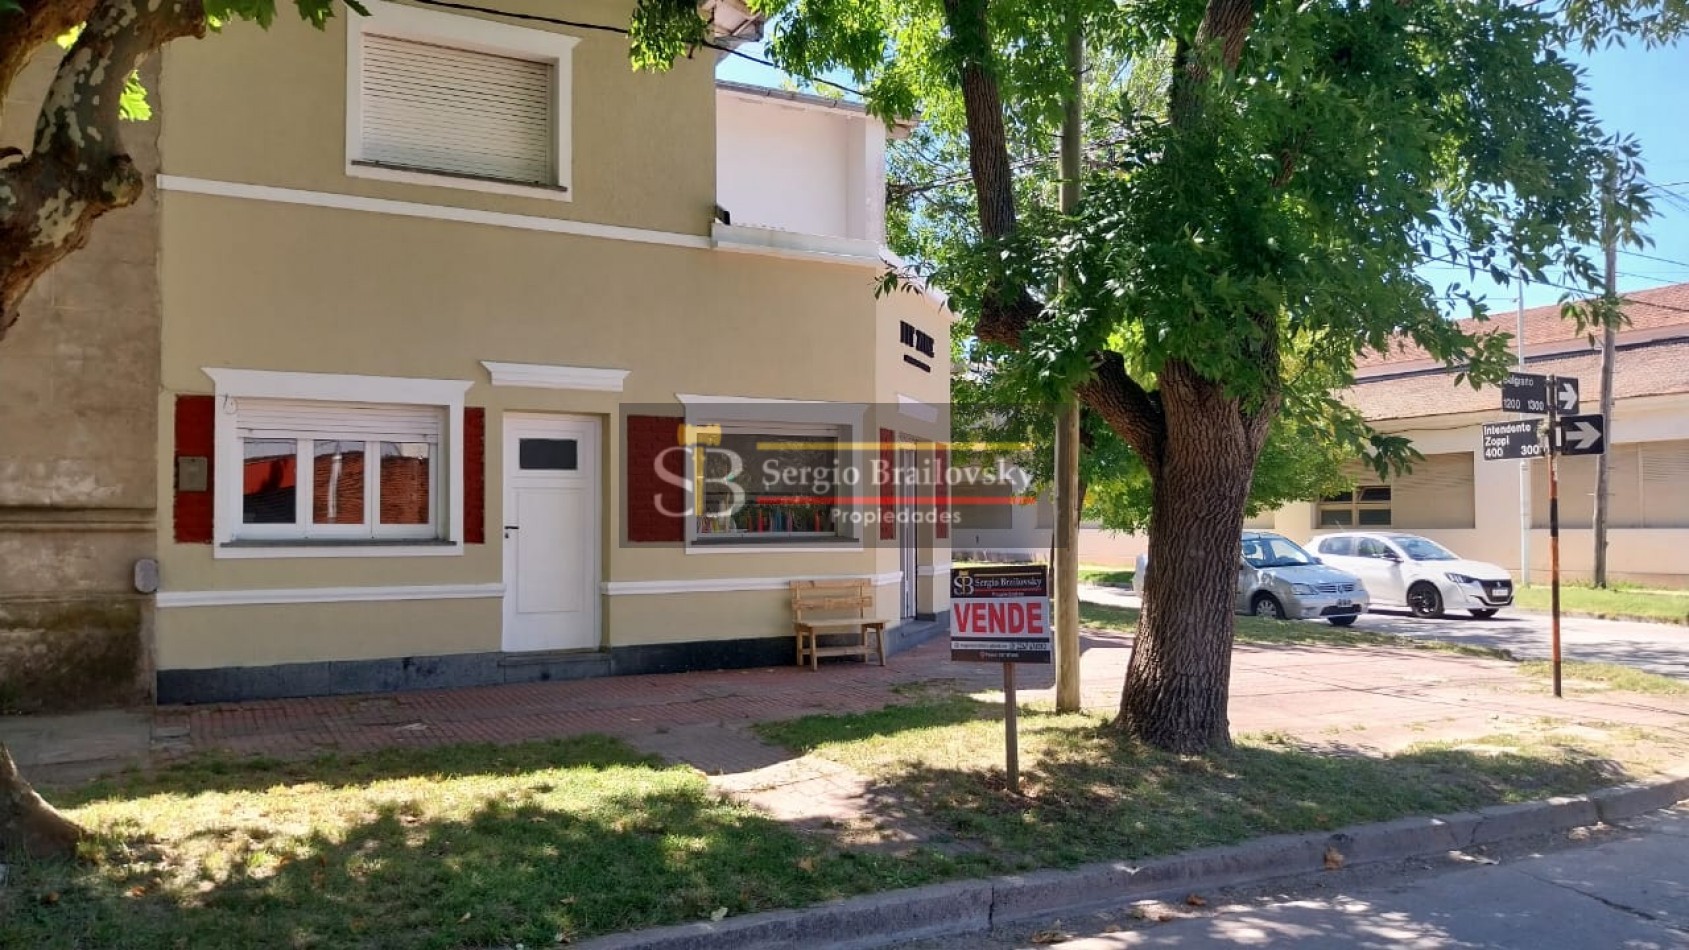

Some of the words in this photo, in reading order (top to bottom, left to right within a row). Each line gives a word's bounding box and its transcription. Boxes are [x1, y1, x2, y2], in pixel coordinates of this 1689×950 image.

[1484, 423, 1531, 435] Intendente
[1485, 436, 1510, 447] Zoppi
[1485, 447, 1504, 458] 400
[1520, 445, 1540, 456] 300
[953, 602, 1044, 634] VENDE
